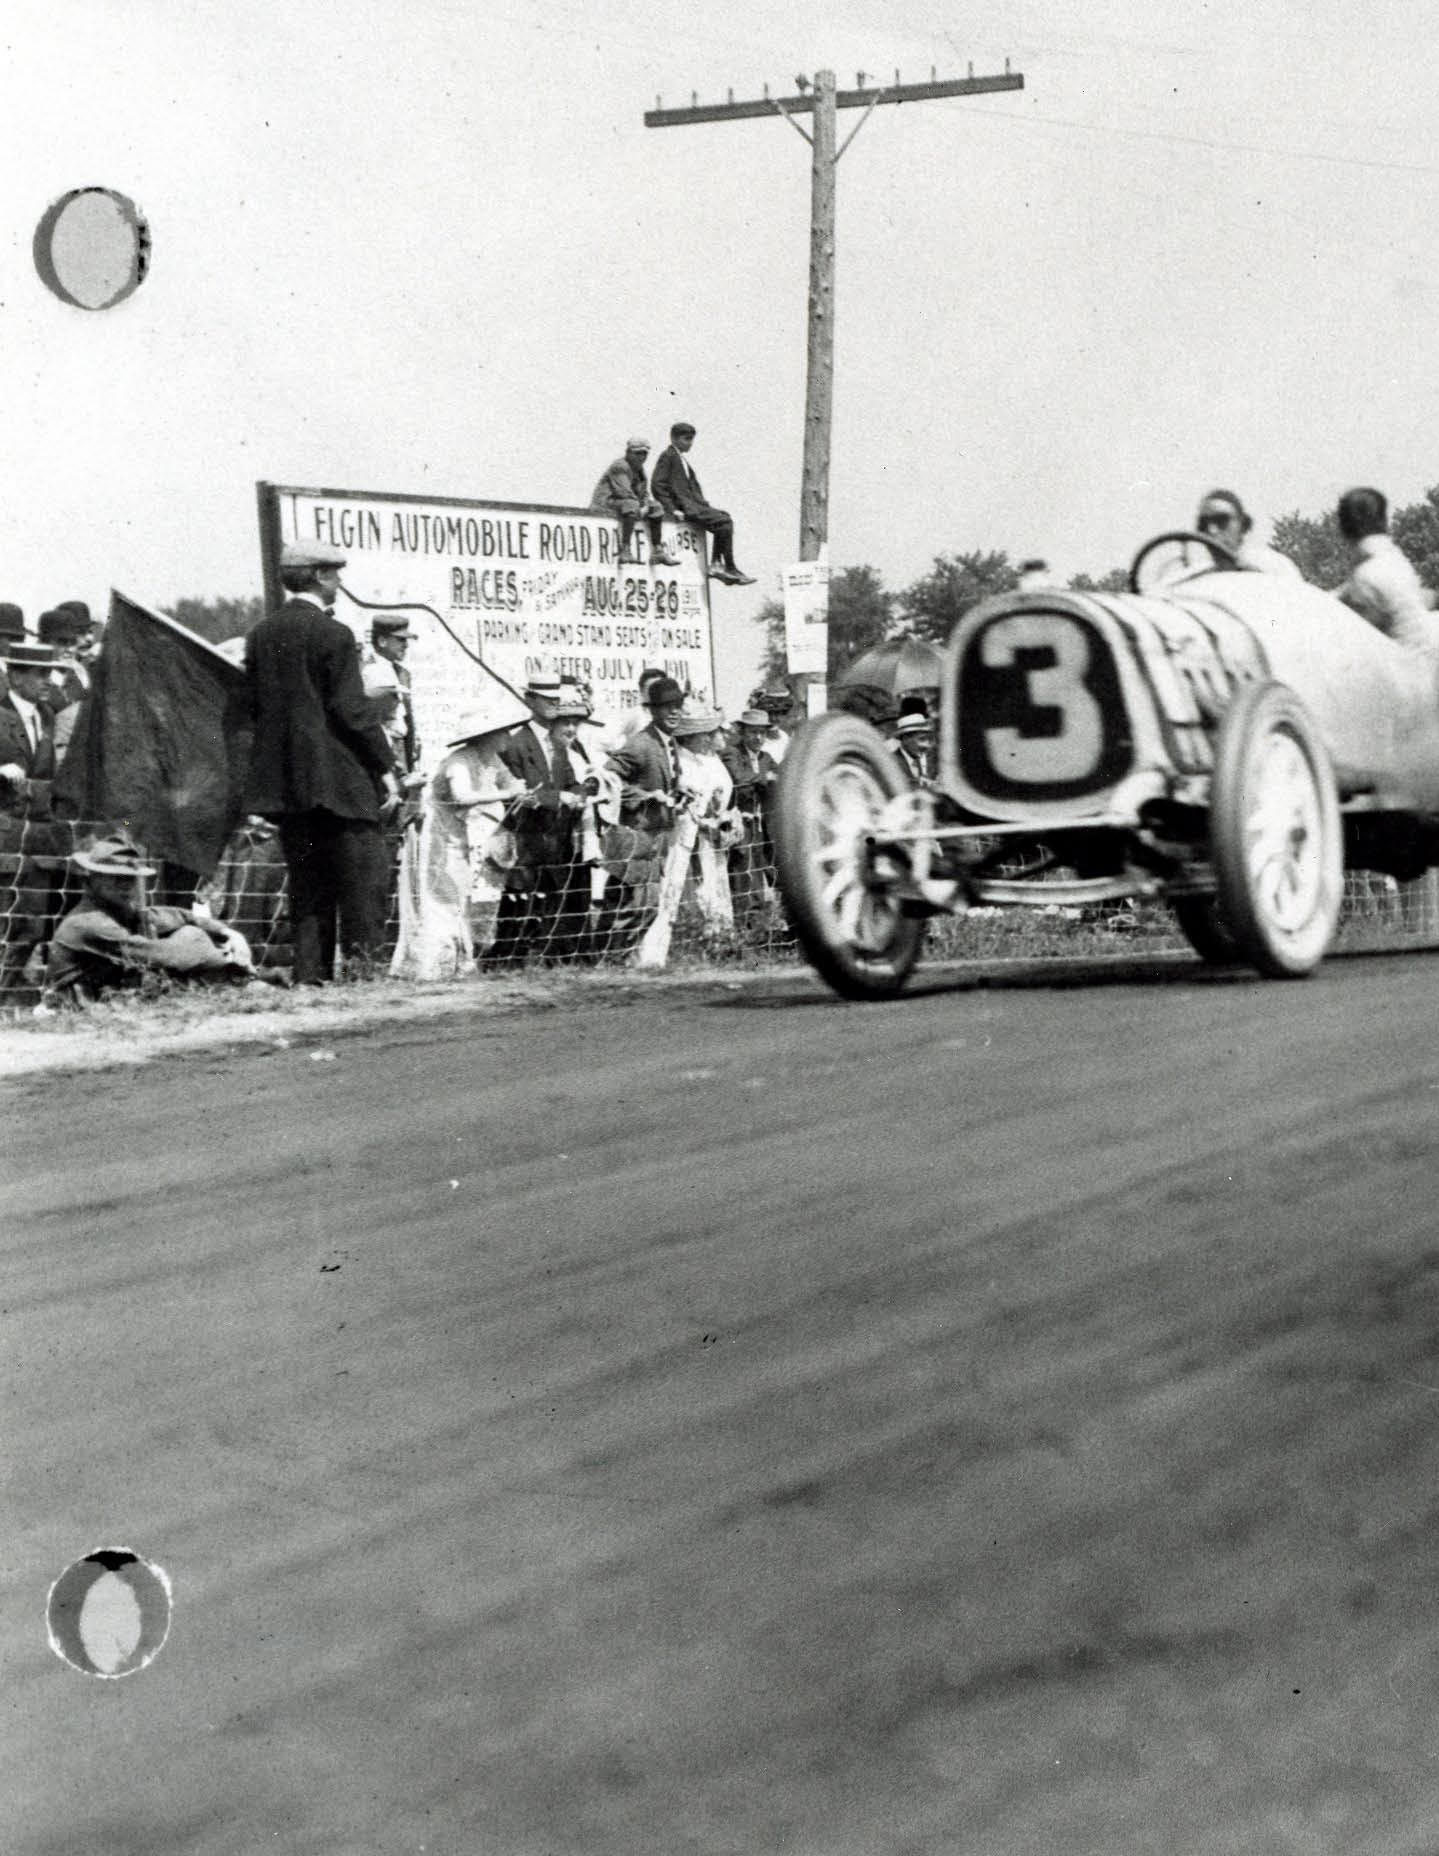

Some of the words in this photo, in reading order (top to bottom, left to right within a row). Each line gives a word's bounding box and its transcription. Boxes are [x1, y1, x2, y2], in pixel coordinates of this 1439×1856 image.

[392, 512, 530, 560] AUTOMOBILE
[540, 522, 592, 563] ROAD
[599, 526, 646, 566] RAE
[483, 619, 529, 645] PARKING
[537, 622, 573, 647] GRAND
[575, 624, 612, 648] STAND
[675, 629, 702, 650] SALE
[596, 658, 634, 681] JULY
[982, 614, 1104, 783] 3
